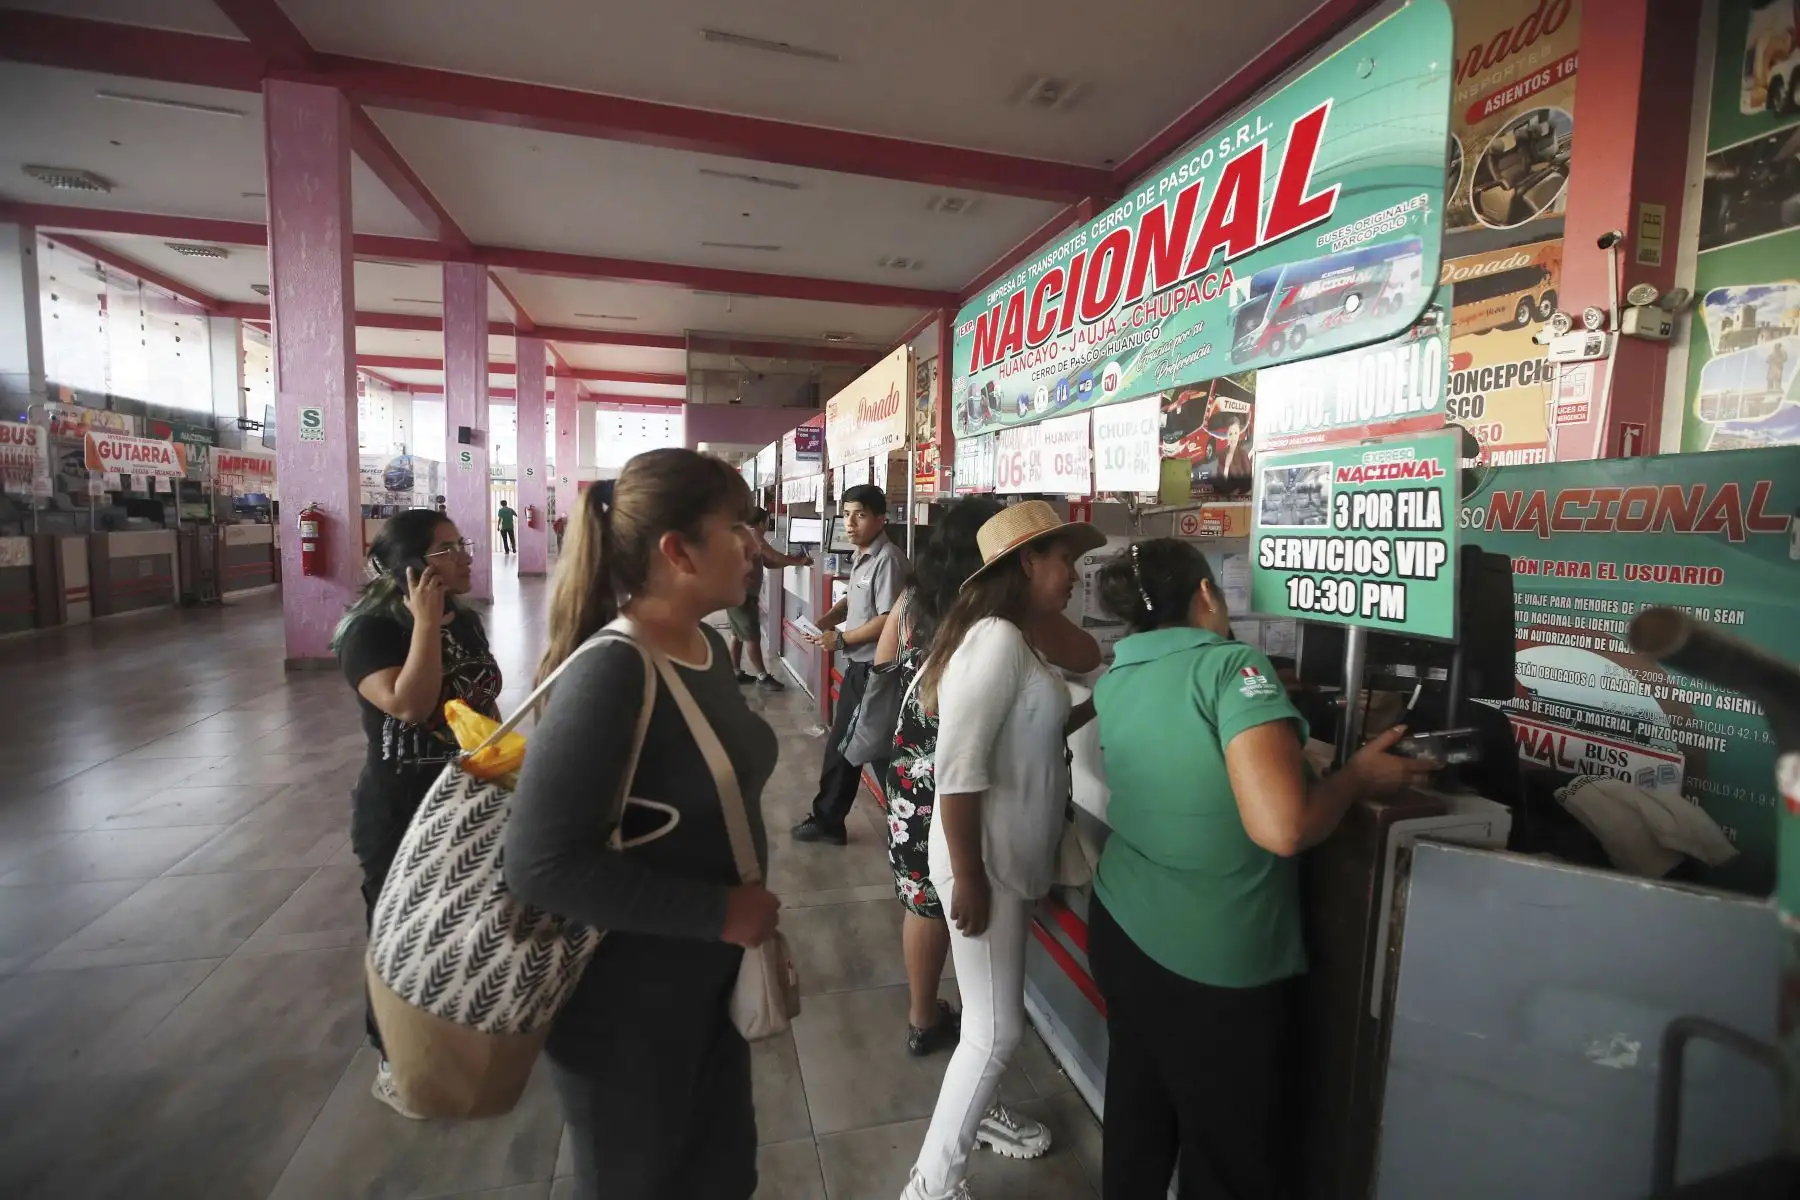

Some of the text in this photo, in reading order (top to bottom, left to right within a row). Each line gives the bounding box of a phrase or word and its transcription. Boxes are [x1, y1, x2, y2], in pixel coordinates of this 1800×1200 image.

[1484, 69, 1551, 115] ASIENTOS
[987, 116, 1274, 306] EMPRESA DE TRANSPORTES CERRO DE PASCO S.R.L.
[1318, 195, 1427, 247] BUSES ORIGINALES
[969, 97, 1342, 375] NACIONAL
[1333, 217, 1406, 250] MARCOPOLO
[1000, 342, 1058, 379] HUANCAYO
[1132, 268, 1234, 327] CHUPACA
[1032, 364, 1056, 381] CERRO
[1058, 361, 1069, 375] DE
[1070, 349, 1098, 369] PASCO
[1107, 327, 1160, 356] HUANUCO
[1336, 337, 1442, 423] MODELO
[303, 410, 320, 427] S
[0, 425, 36, 445] BUS
[98, 441, 171, 464] GUTARRA
[461, 452, 471, 462] S
[1364, 449, 1414, 463] EXPRESO
[527, 468, 533, 476] S
[1336, 460, 1444, 483] NACIONAL
[1336, 490, 1442, 529] 3 POR FILA
[1484, 480, 1791, 542] NACIONAL
[1260, 538, 1445, 577] SERVICIOS VIP
[1544, 560, 1591, 579] PARA
[1597, 563, 1618, 580] EL
[1624, 564, 1725, 586] USUARIO
[1287, 576, 1356, 614] 10:30
[1361, 582, 1405, 620] PM
[1524, 594, 1548, 607] VIAJE
[1550, 596, 1571, 609] PARA
[1574, 598, 1618, 614] MENORES
[1621, 602, 1634, 615] DE
[1695, 608, 1709, 622] NO
[1713, 609, 1744, 625] SEAN
[1531, 612, 1572, 628] NACIONAL
[1588, 618, 1632, 634] IDENTID
[1531, 629, 1591, 649] AUTORIZACIÓN
[1595, 638, 1606, 651] DE
[1539, 666, 1587, 686] OBLIGADOS
[1589, 674, 1595, 687] A
[1601, 676, 1635, 695] VIAJAR
[1639, 683, 1651, 697] EN
[1654, 685, 1667, 700] SU
[1672, 688, 1712, 706] PROPIO
[1532, 701, 1542, 713] DE
[1545, 704, 1571, 719] FUEGO
[1585, 711, 1632, 733] MATERIAL
[1638, 723, 1727, 752] PUNZOCORTANTE
[1686, 718, 1734, 736] ARTICULO
[1585, 742, 1629, 768] BUSS
[1578, 759, 1632, 784] NUEVO
